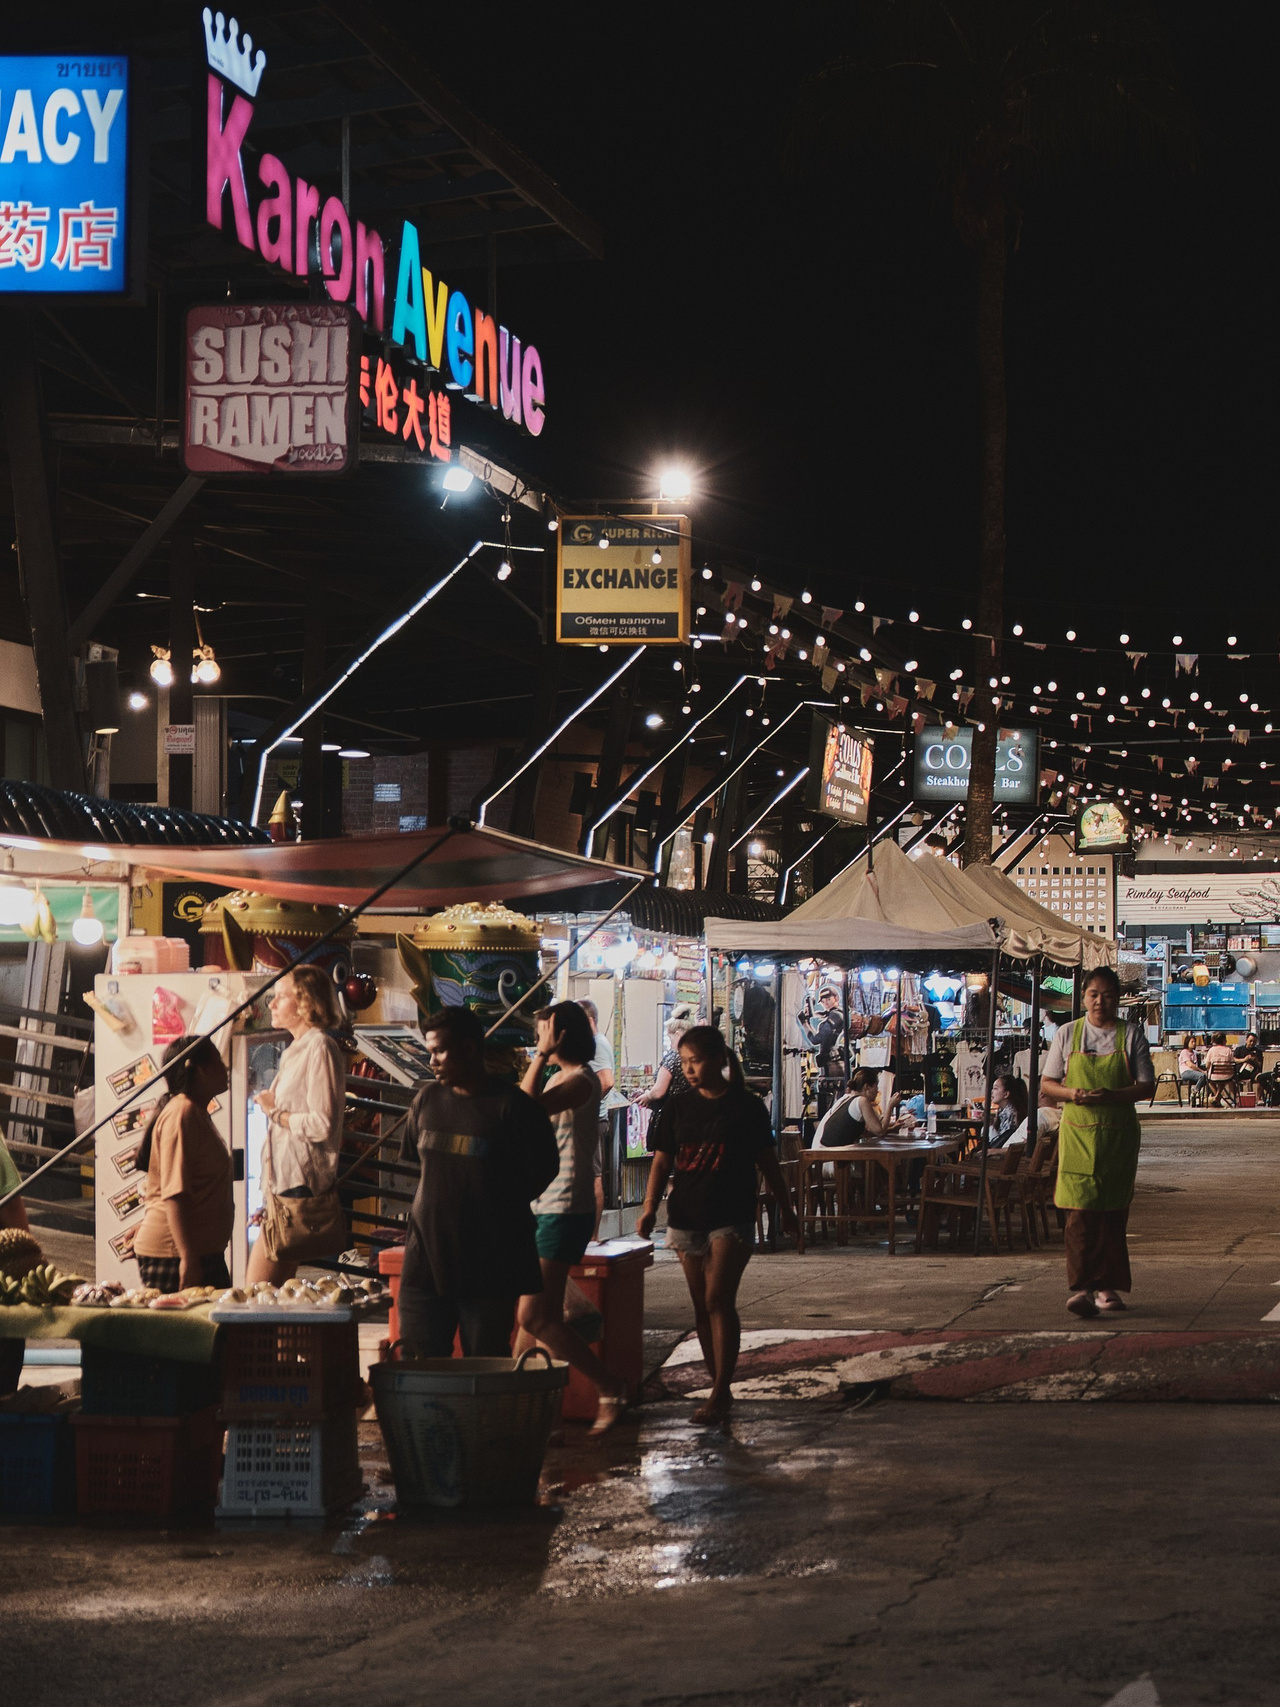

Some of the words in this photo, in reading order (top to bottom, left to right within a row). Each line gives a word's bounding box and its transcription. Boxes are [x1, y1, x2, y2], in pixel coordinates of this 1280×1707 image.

[56, 62, 125, 78] ขายยา
[0, 201, 118, 272] 药店
[206, 73, 385, 332] Karon
[392, 219, 546, 436] Avenue
[191, 321, 349, 384] SUSHI
[190, 394, 348, 447] RAMEN
[563, 568, 678, 589] EXCHANGE
[575, 615, 616, 625] Обмен
[619, 617, 666, 625] валюты
[1001, 778, 1021, 788] Bar
[1125, 887, 1164, 904] Rimlay
[1166, 887, 1211, 903] Seafood
